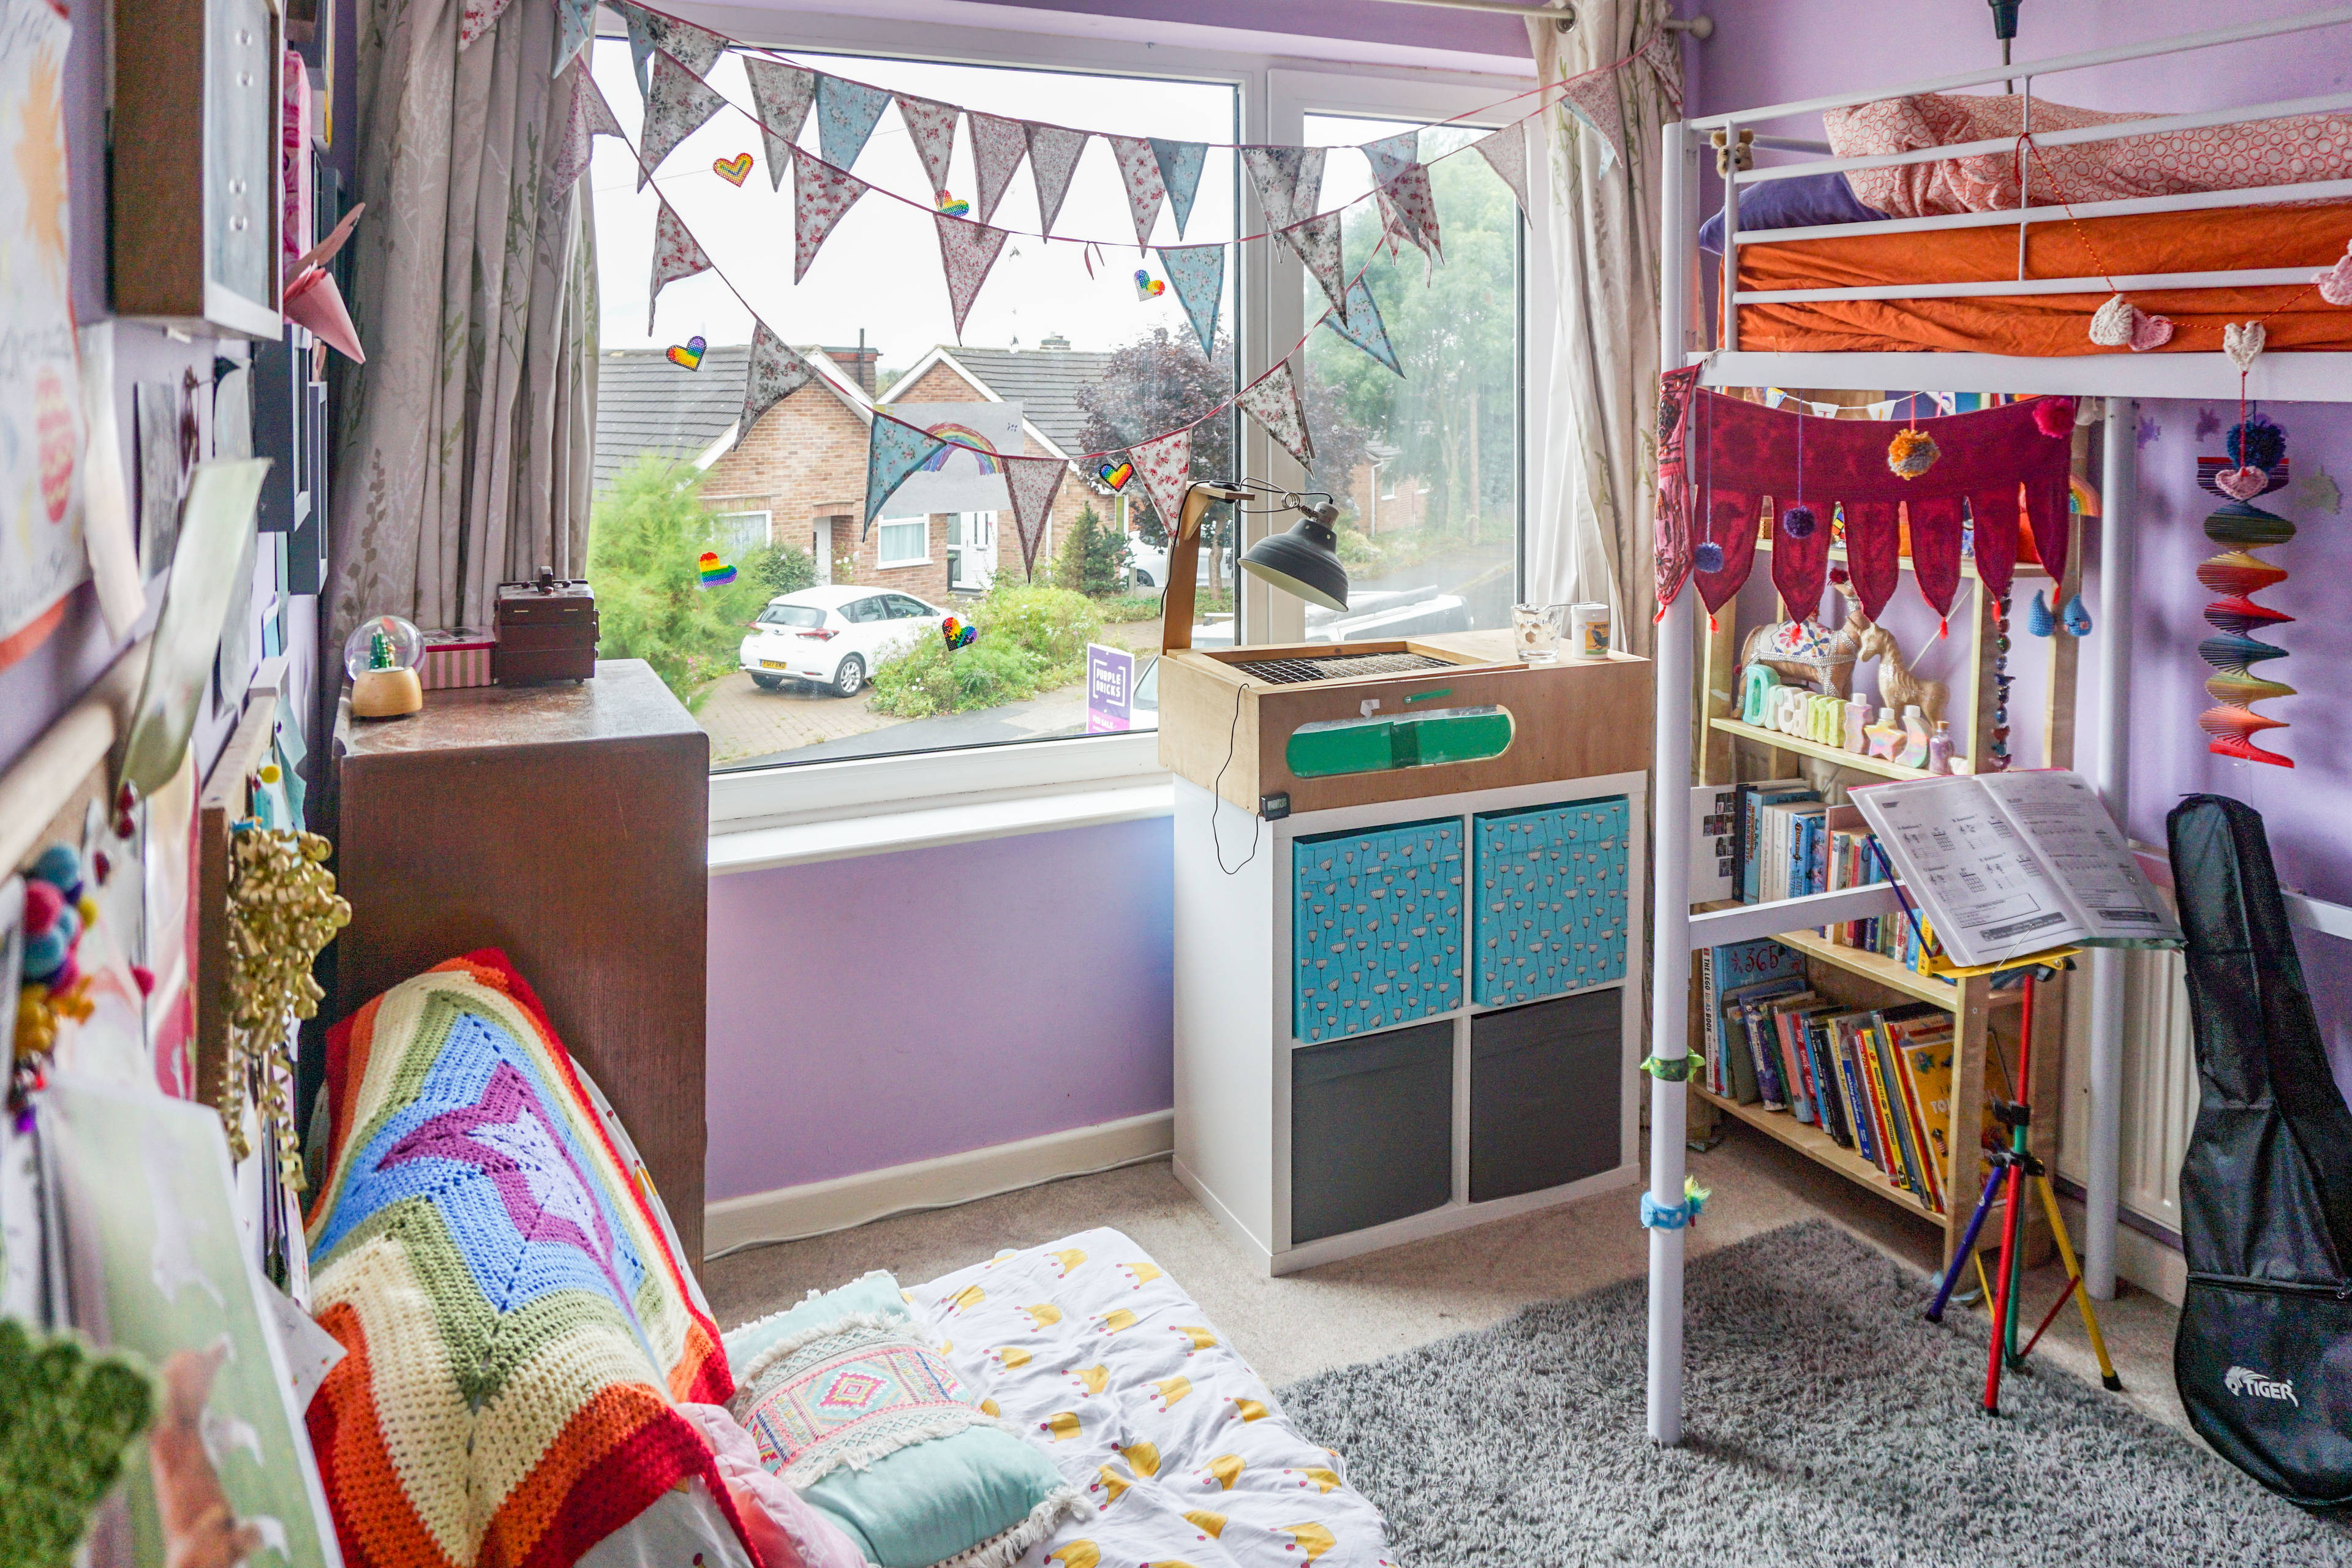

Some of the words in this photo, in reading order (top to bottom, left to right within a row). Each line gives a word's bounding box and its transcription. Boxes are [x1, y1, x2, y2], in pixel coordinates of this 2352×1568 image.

[1096, 668, 1121, 685] PURPLE
[1096, 682, 1121, 698] BRICKS
[1741, 665, 1848, 748] Dream
[1746, 944, 1779, 972] 365
[1851, 1096, 1861, 1124] shadows
[2243, 1380, 2299, 1408] TIGER
